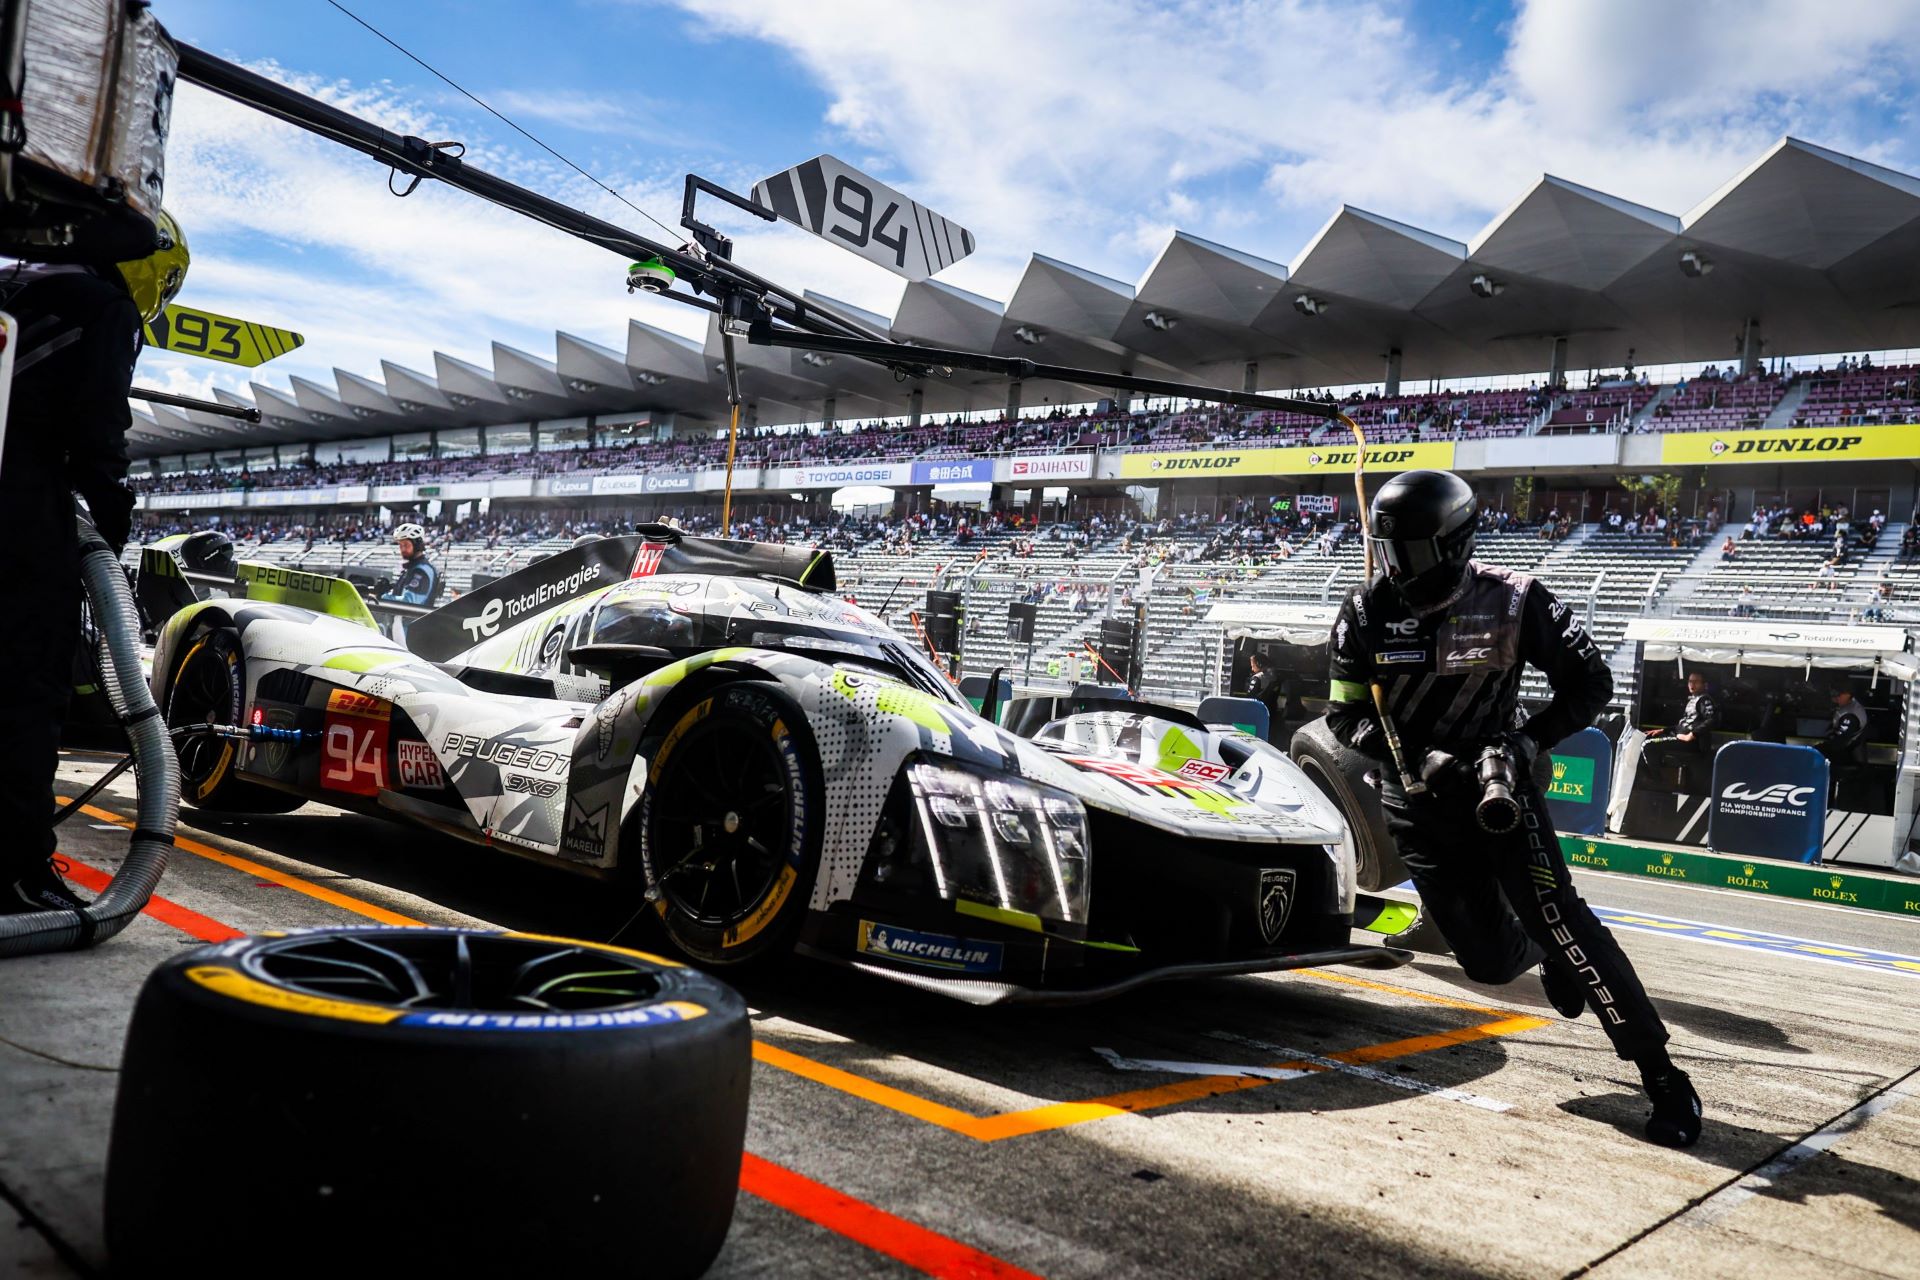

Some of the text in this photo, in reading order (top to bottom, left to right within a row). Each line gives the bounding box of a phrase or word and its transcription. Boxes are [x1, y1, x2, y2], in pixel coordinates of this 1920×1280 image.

[830, 174, 908, 268] 94
[174, 312, 241, 360] 93
[1733, 437, 1862, 453] DUNLOP
[1030, 460, 1088, 474] DAIHATSU
[1163, 456, 1240, 470] DUNLOP
[657, 478, 689, 489] LEXUS
[808, 470, 892, 482] TOYODA GOSEI
[633, 550, 662, 574] HY
[256, 567, 337, 595] PEUGEOT
[505, 563, 601, 619] TotalEnergies
[336, 694, 380, 715] DHL
[327, 723, 385, 788] 94
[400, 743, 437, 761] HYPER
[441, 732, 573, 775] PEUGEOT
[401, 760, 443, 786] CAR
[505, 773, 562, 799] 9X8
[1548, 782, 1584, 796] LEX
[1722, 782, 1816, 807] WEC
[785, 752, 805, 856] MICHELIN
[1720, 808, 1776, 818] CHAMPIONSHIP
[1734, 803, 1760, 811] WORLD
[1762, 806, 1807, 817] ENDURANCE
[566, 837, 603, 856] MARELLI
[1571, 853, 1609, 867] ROLEX
[1646, 864, 1687, 878] ROLEX
[1727, 875, 1769, 890] ROLEX
[1813, 887, 1858, 902] ROLEX
[891, 938, 989, 963] MICHELIN
[1536, 885, 1626, 1026] PEUGEOT
[427, 1009, 649, 1028] MICHELIN
